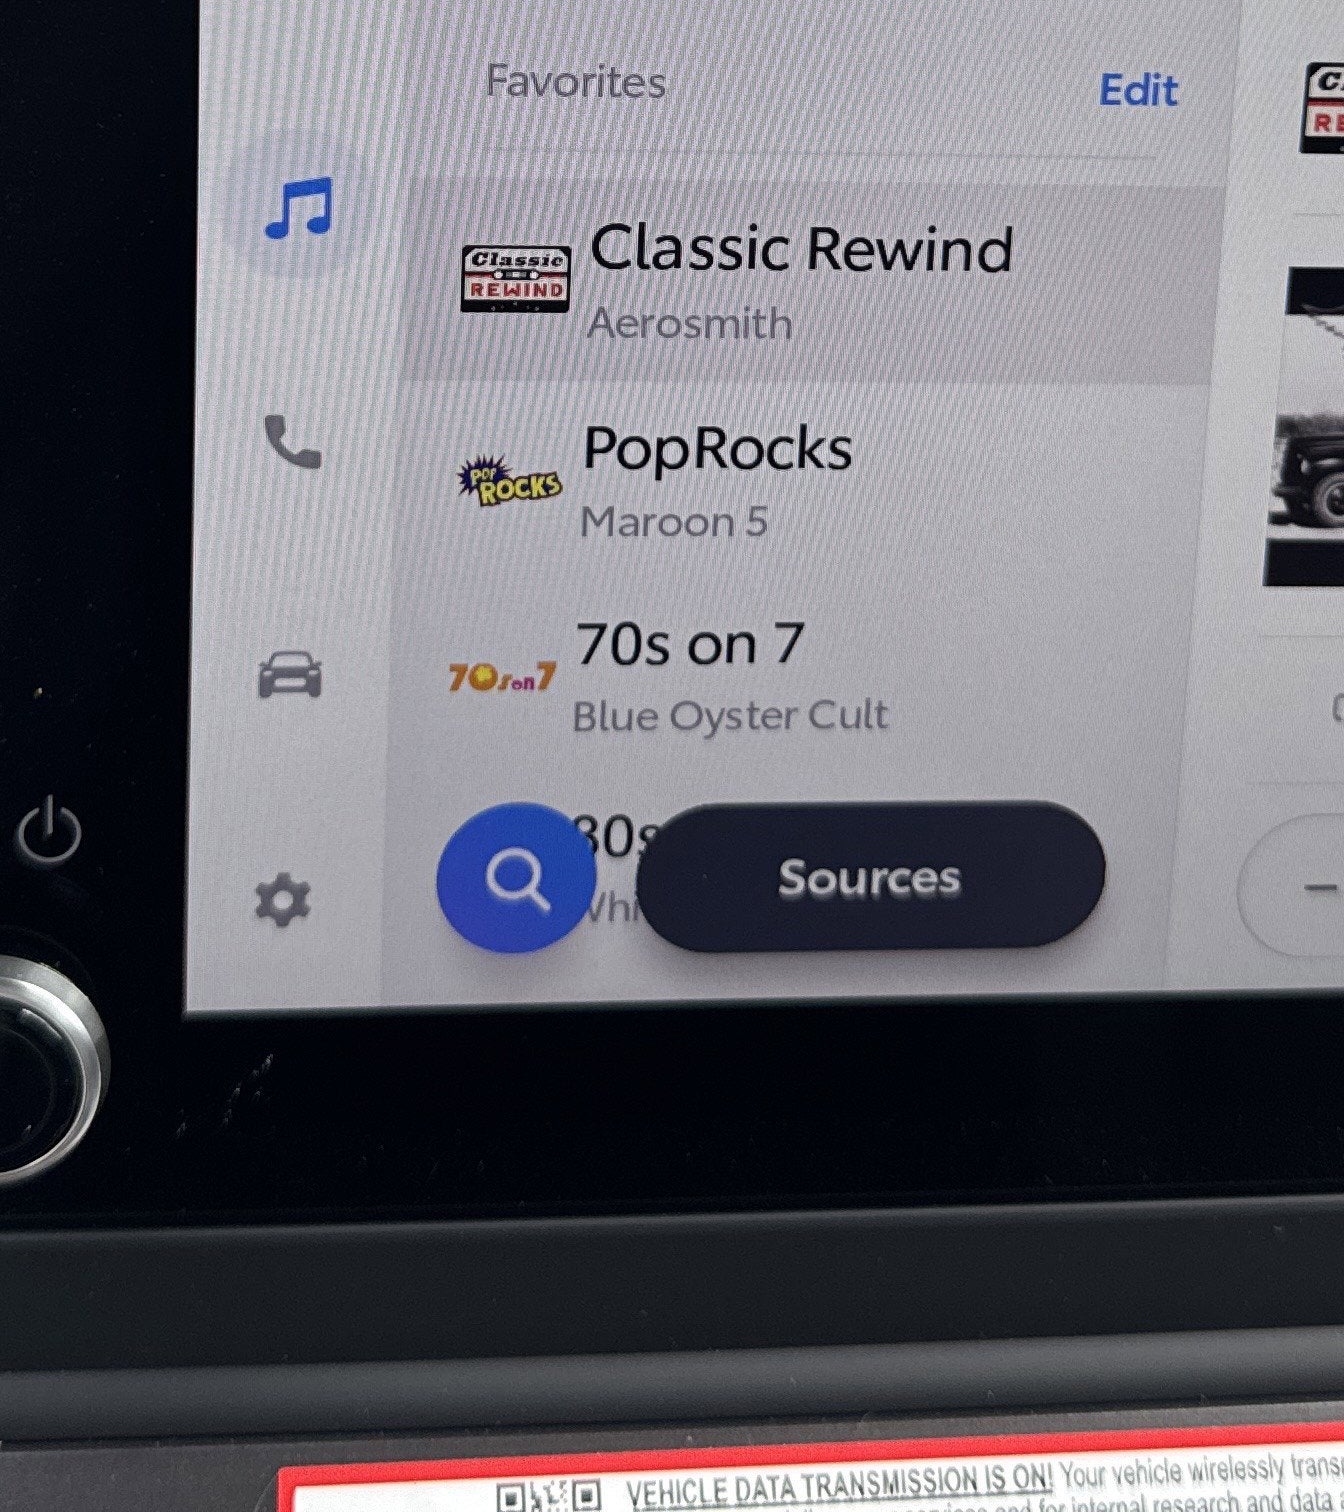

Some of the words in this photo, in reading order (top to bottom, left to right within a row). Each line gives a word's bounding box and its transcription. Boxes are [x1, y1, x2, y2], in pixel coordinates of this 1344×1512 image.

[487, 63, 666, 99] Favorites
[1100, 72, 1179, 107] Edit
[471, 251, 564, 267] Classic
[591, 222, 790, 273] Classic
[808, 226, 1014, 274] Rewind
[470, 282, 564, 298] REWIND
[587, 306, 793, 341] Aerosmith
[585, 424, 853, 481] PopRocks
[480, 474, 561, 504] ROCKS
[581, 506, 735, 537] Maroon
[746, 506, 768, 537] 5
[577, 621, 670, 665] 70s
[688, 631, 756, 665] on
[775, 621, 805, 663] 7
[573, 700, 659, 732] Blue
[670, 699, 799, 739] Oyster
[809, 697, 890, 730] Cult
[778, 859, 962, 898] Sources
[626, 1476, 728, 1506] VEHICLE
[735, 1473, 797, 1502] DATA
[801, 1465, 978, 1497] TRANSMISSION
[985, 1464, 1006, 1490] IS
[1013, 1461, 1053, 1489] ON!
[1059, 1460, 1106, 1487] Your
[1112, 1457, 1183, 1486] vehicle
[1188, 1452, 1284, 1485] wirelessly
[1153, 1490, 1240, 1512] research
[1247, 1486, 1283, 1512] and
[1290, 1485, 1334, 1512] data
